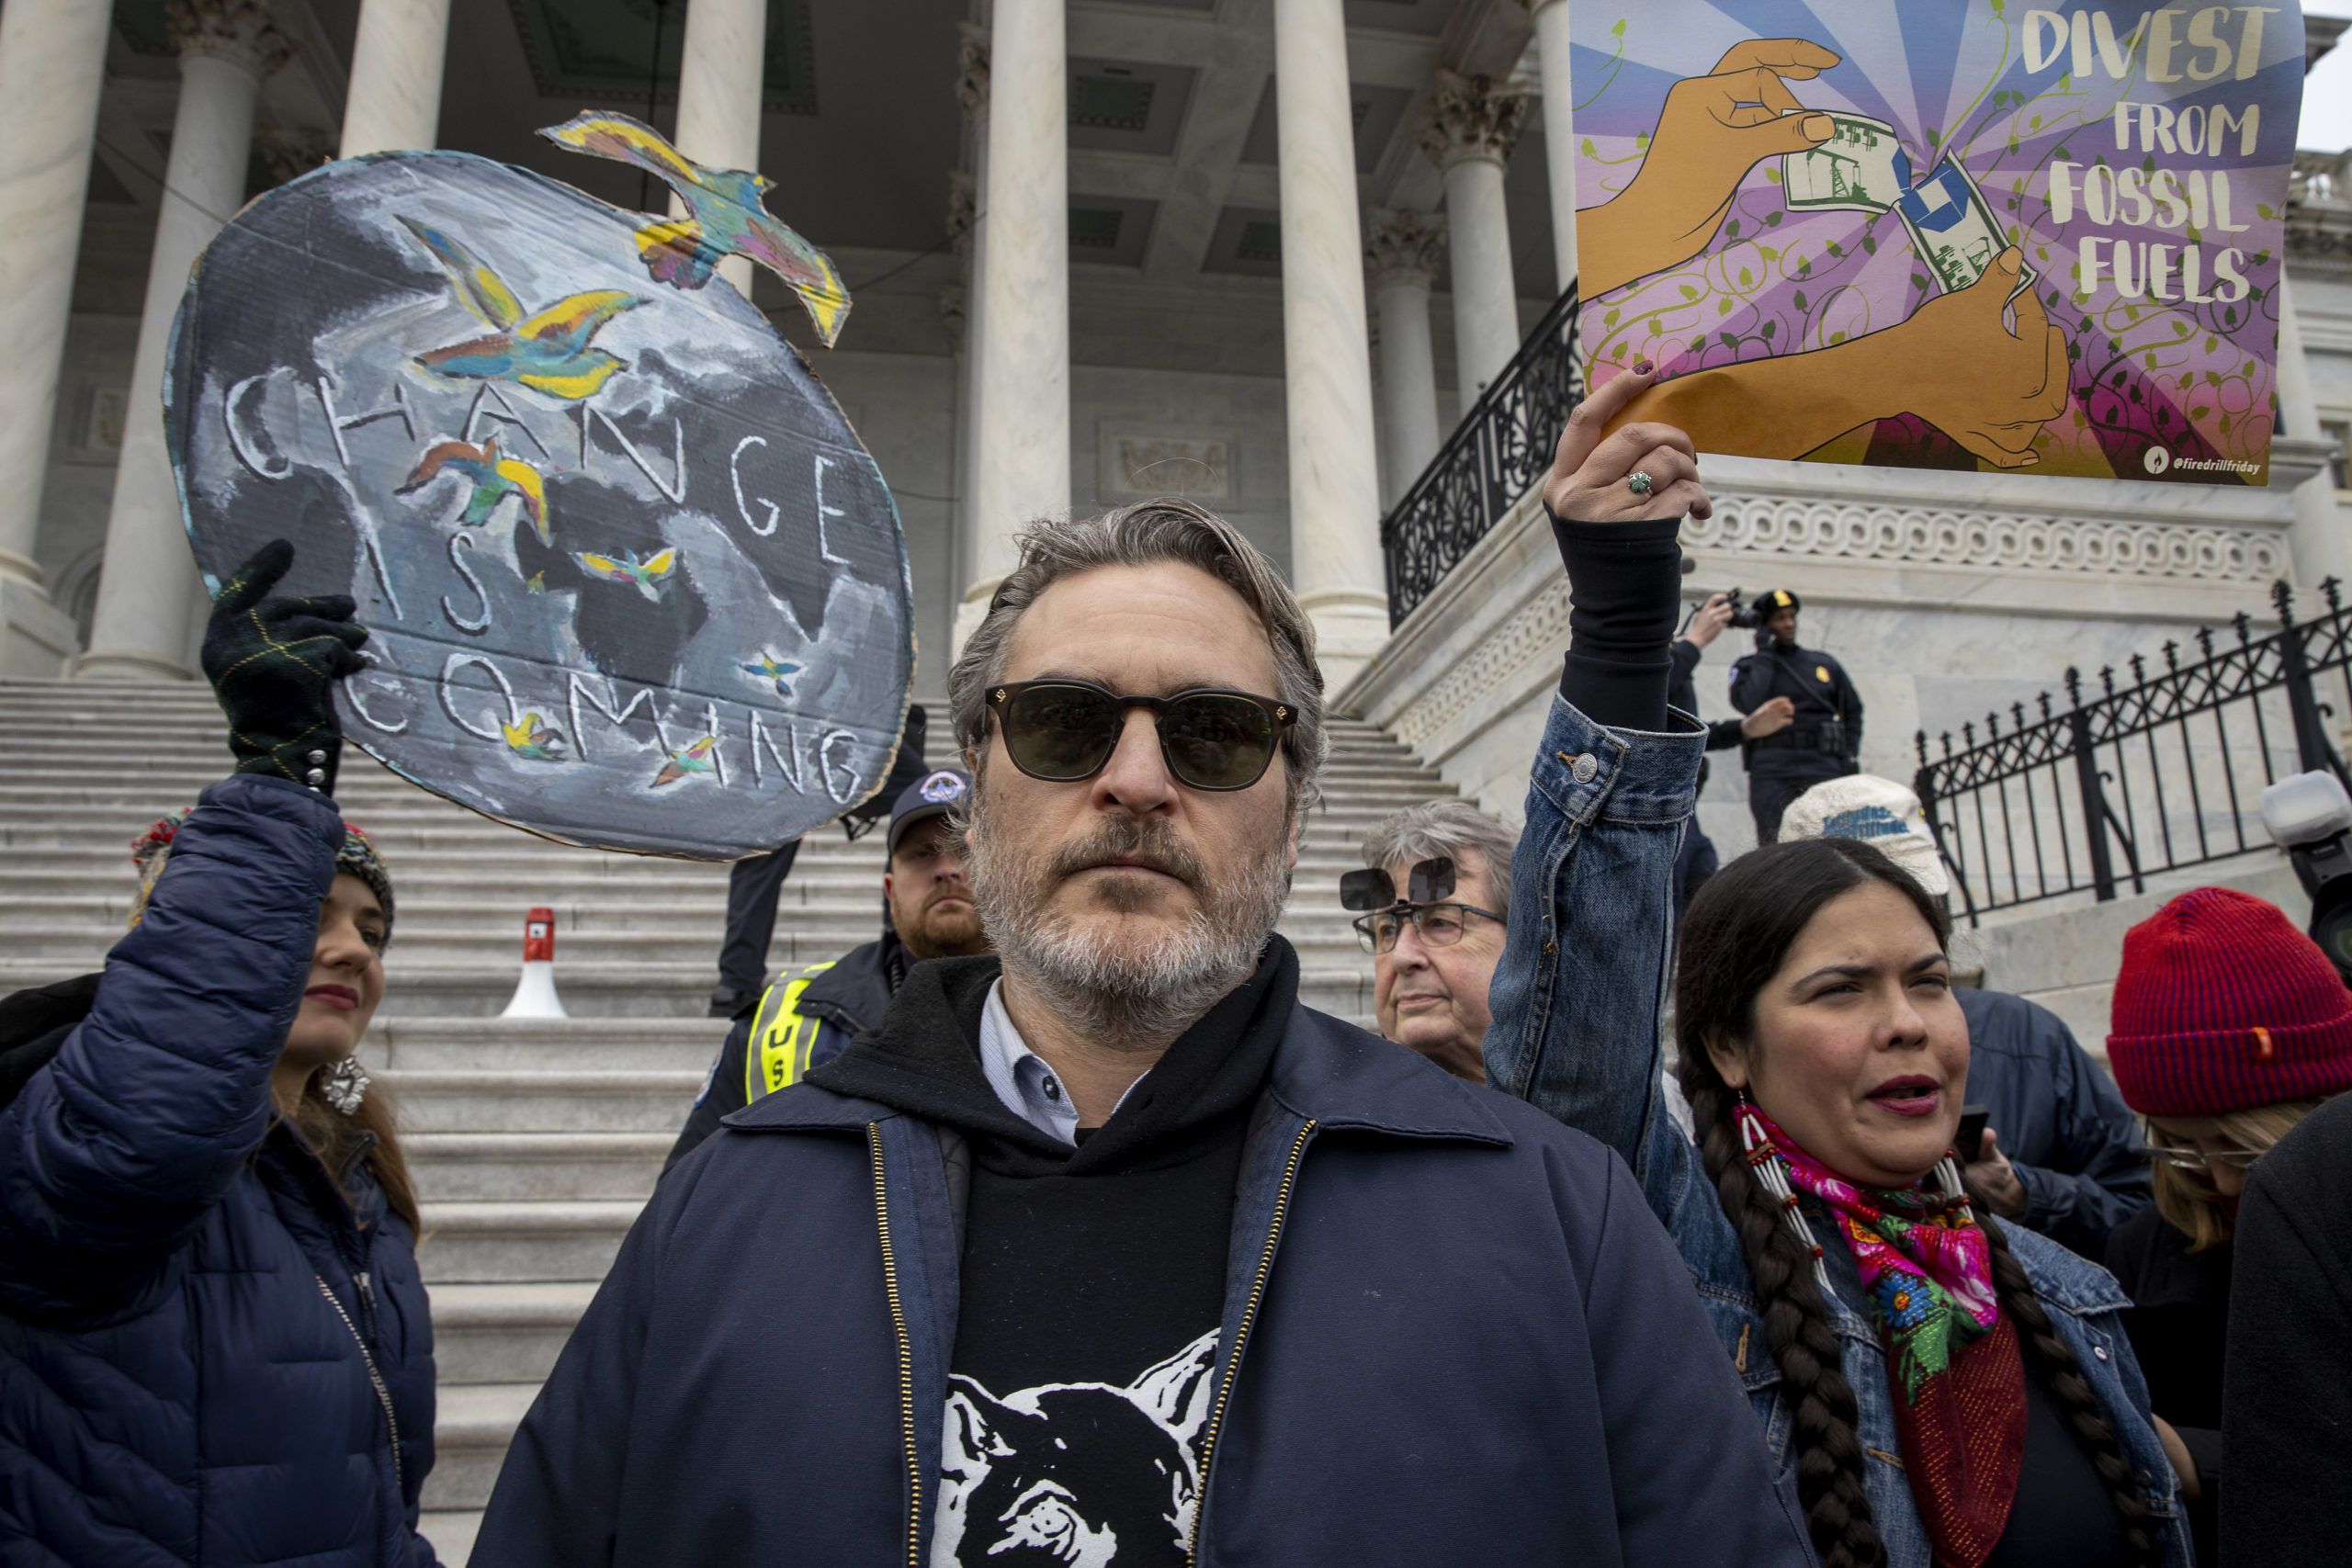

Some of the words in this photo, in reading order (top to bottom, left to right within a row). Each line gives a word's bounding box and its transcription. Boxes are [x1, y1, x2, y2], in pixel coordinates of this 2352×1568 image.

[2022, 6, 2282, 83] DIVEST
[2115, 101, 2260, 157] FROM
[2049, 160, 2251, 232] FOSSIL
[2078, 236, 2251, 304] FUELS
[224, 367, 853, 565] CHANGE
[2173, 457, 2261, 475] @firedrillfriday
[365, 525, 492, 636] IS
[341, 649, 862, 805] COMING
